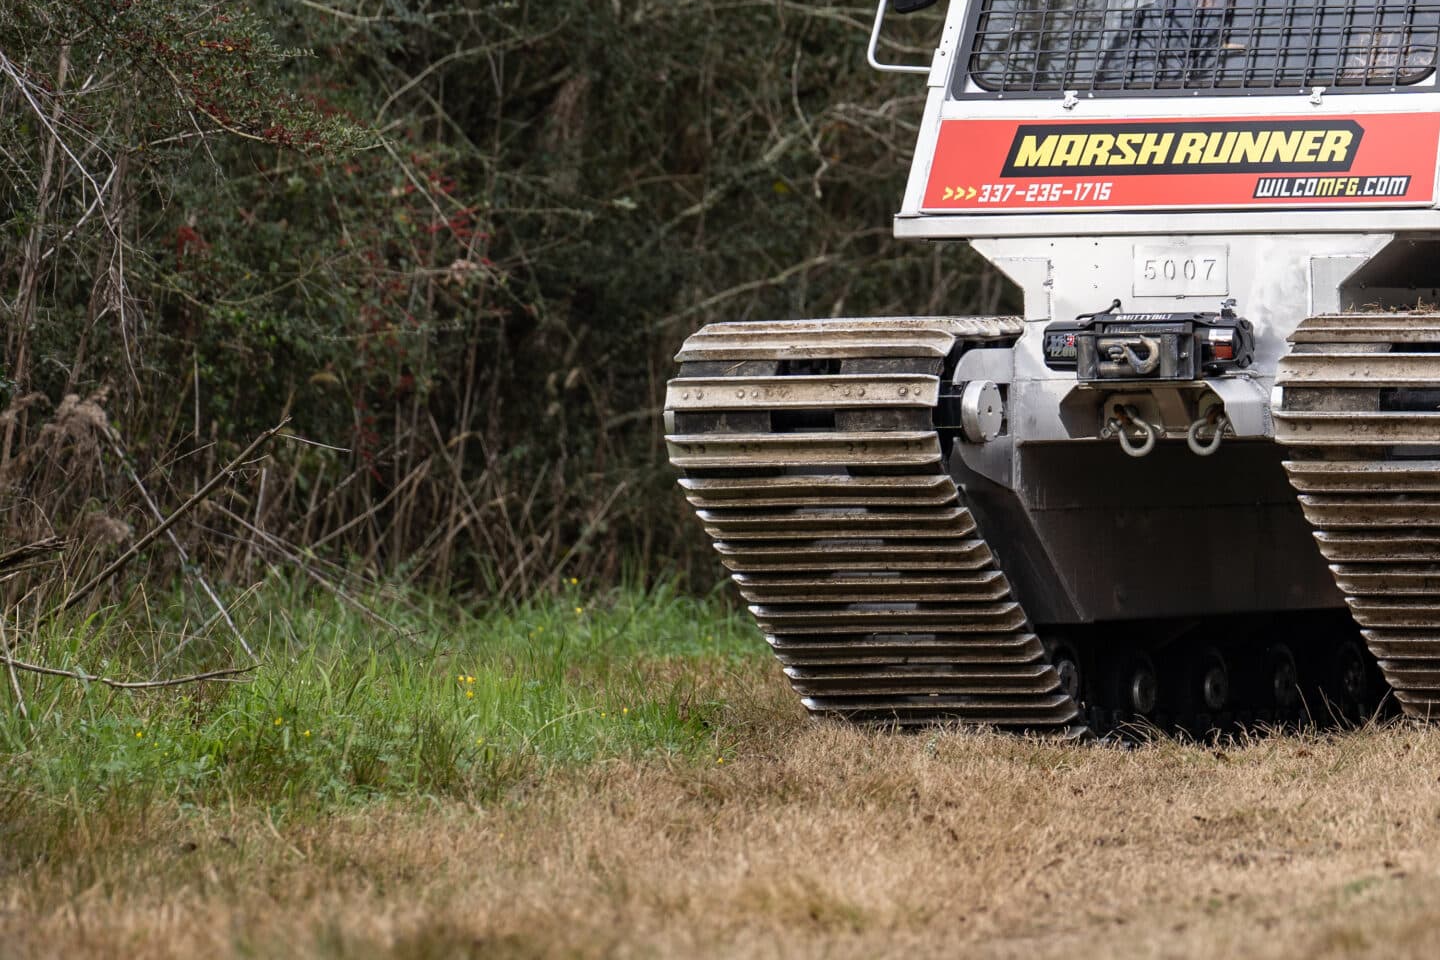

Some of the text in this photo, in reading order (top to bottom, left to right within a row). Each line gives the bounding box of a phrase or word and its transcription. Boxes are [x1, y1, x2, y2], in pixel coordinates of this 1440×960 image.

[1013, 129, 1354, 167] MARSH RUNNER
[977, 182, 1113, 203] 337-235-1715
[1255, 176, 1409, 197] WILCOMFG.COM
[1144, 259, 1217, 281] 5007
